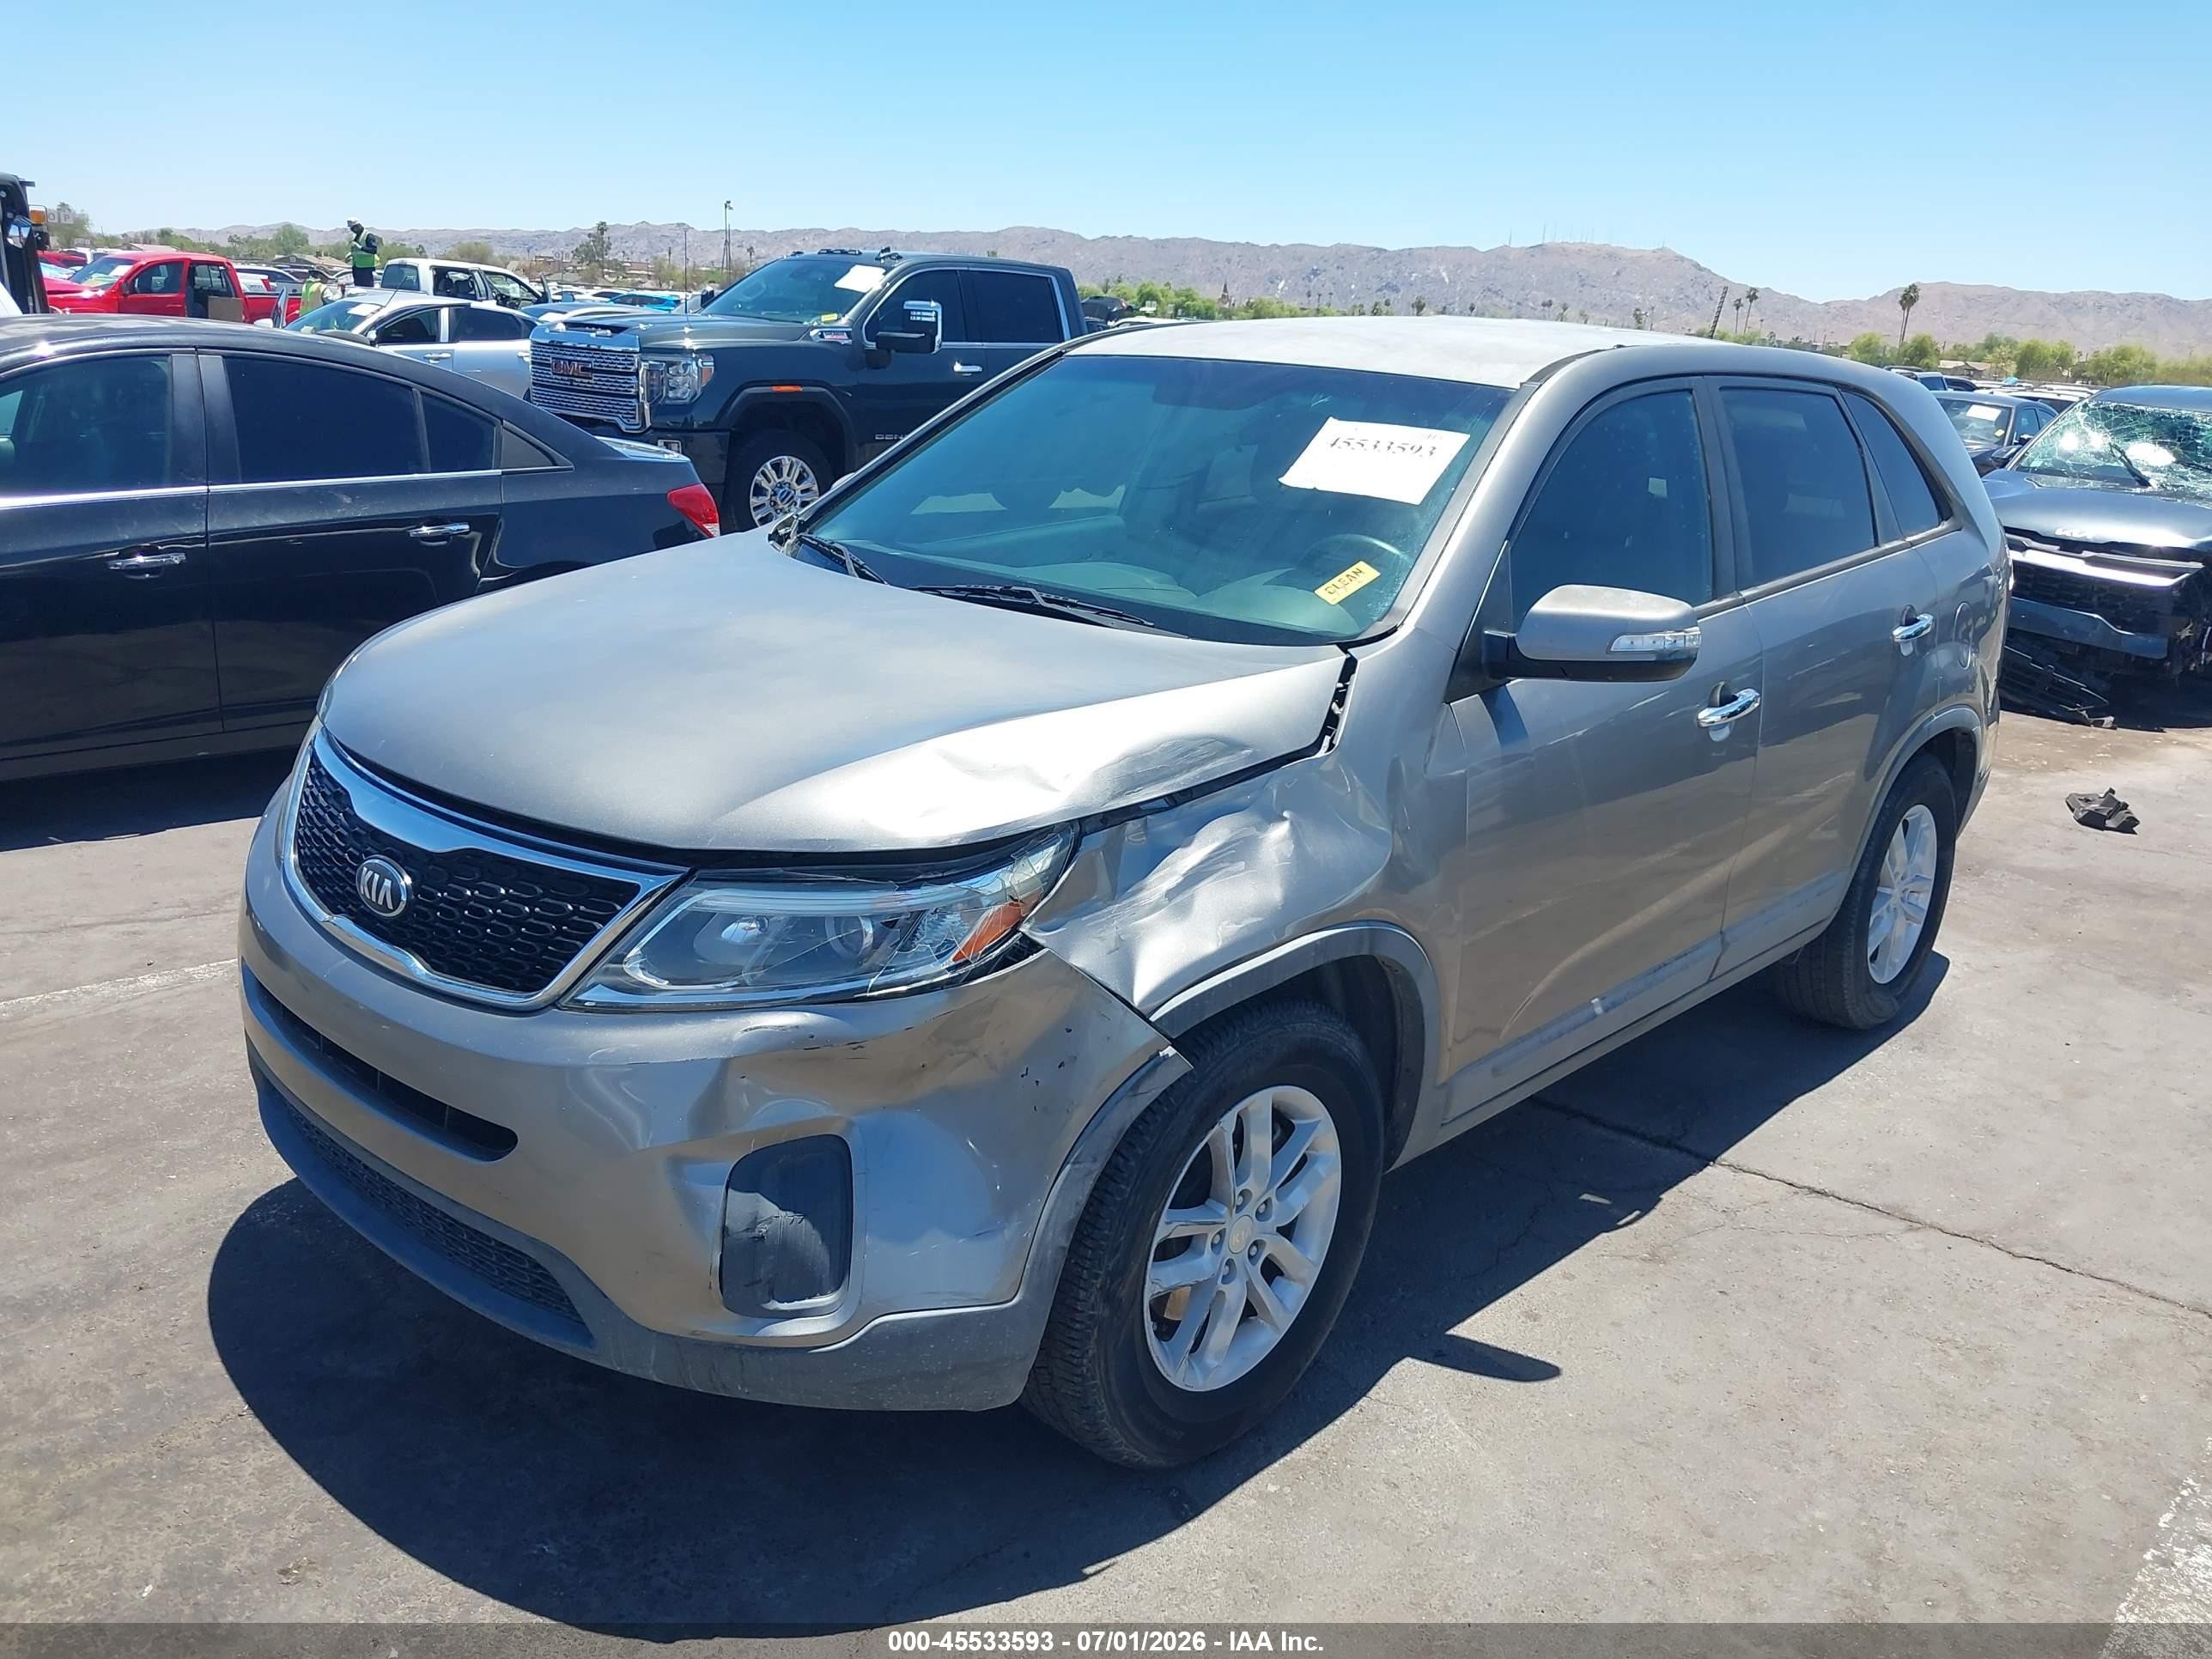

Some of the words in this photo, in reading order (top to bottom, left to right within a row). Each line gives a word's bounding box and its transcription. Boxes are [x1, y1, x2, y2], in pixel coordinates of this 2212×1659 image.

[552, 358, 592, 377] GMC
[1324, 568, 1365, 595] CLEAN
[359, 866, 394, 910] KIA
